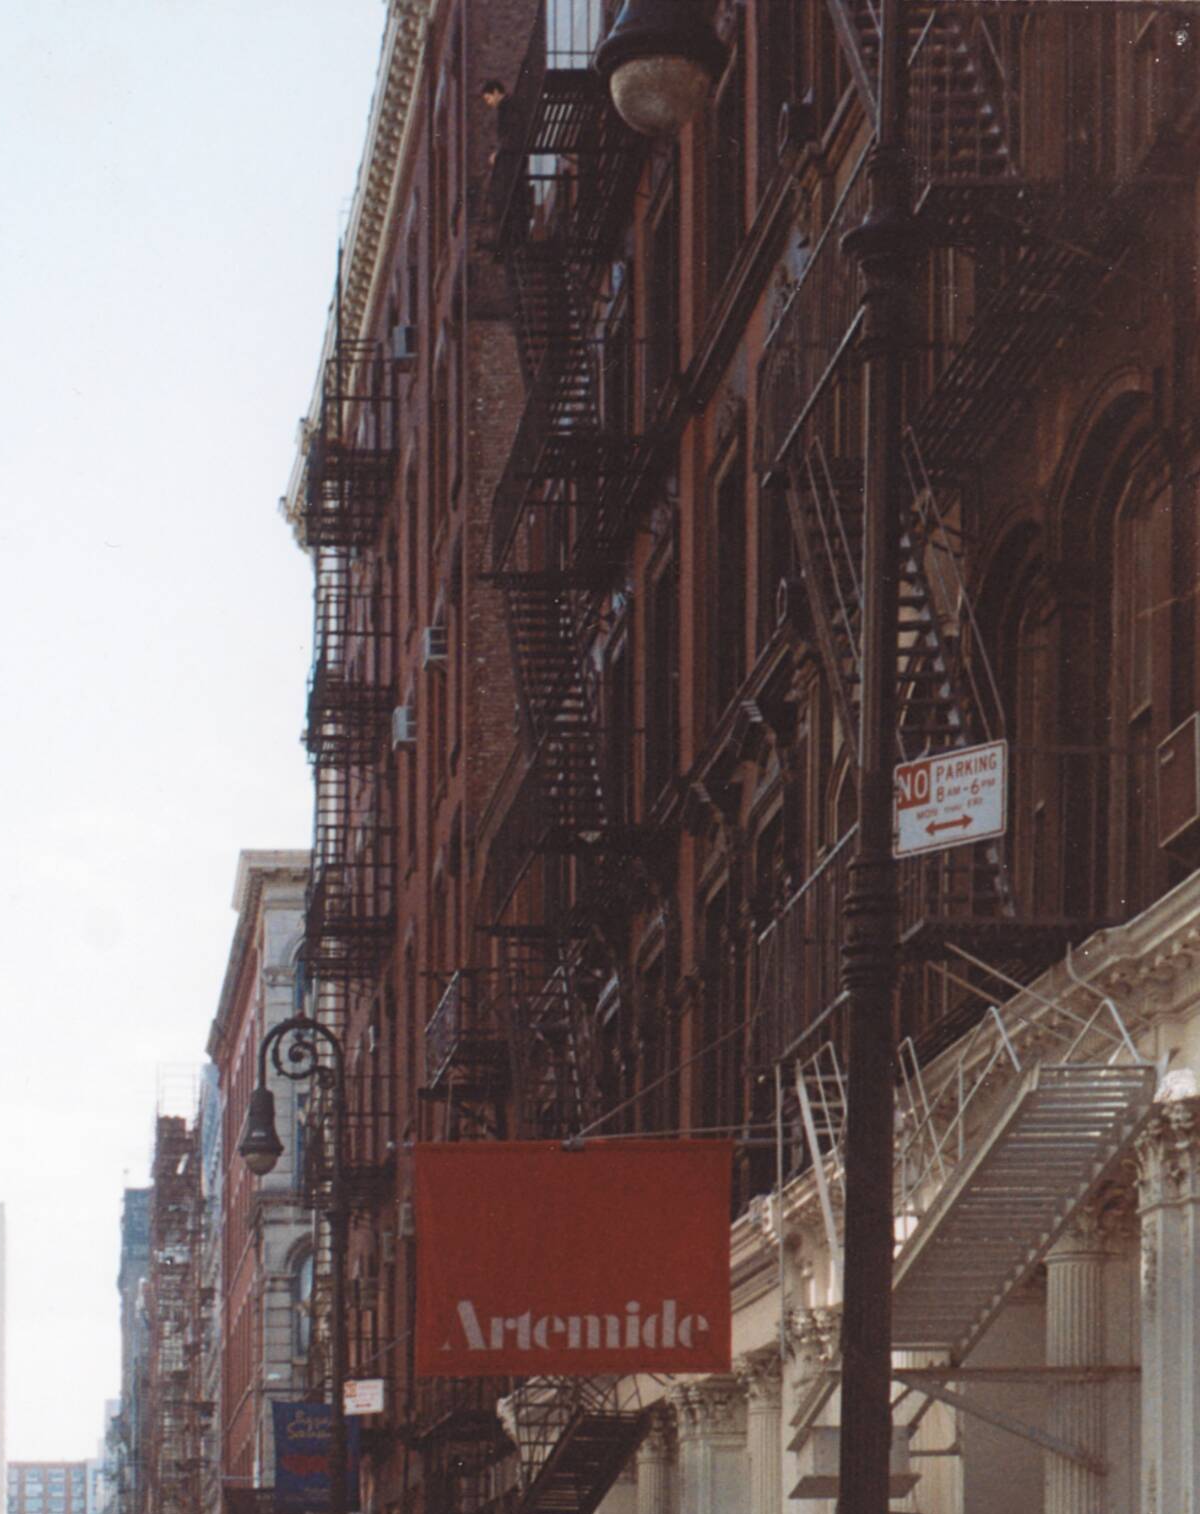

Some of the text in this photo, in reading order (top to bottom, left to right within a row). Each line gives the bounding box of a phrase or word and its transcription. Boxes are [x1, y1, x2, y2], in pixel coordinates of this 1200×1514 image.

[897, 751, 997, 804] NO PARKING
[441, 1299, 710, 1351] Artemide
